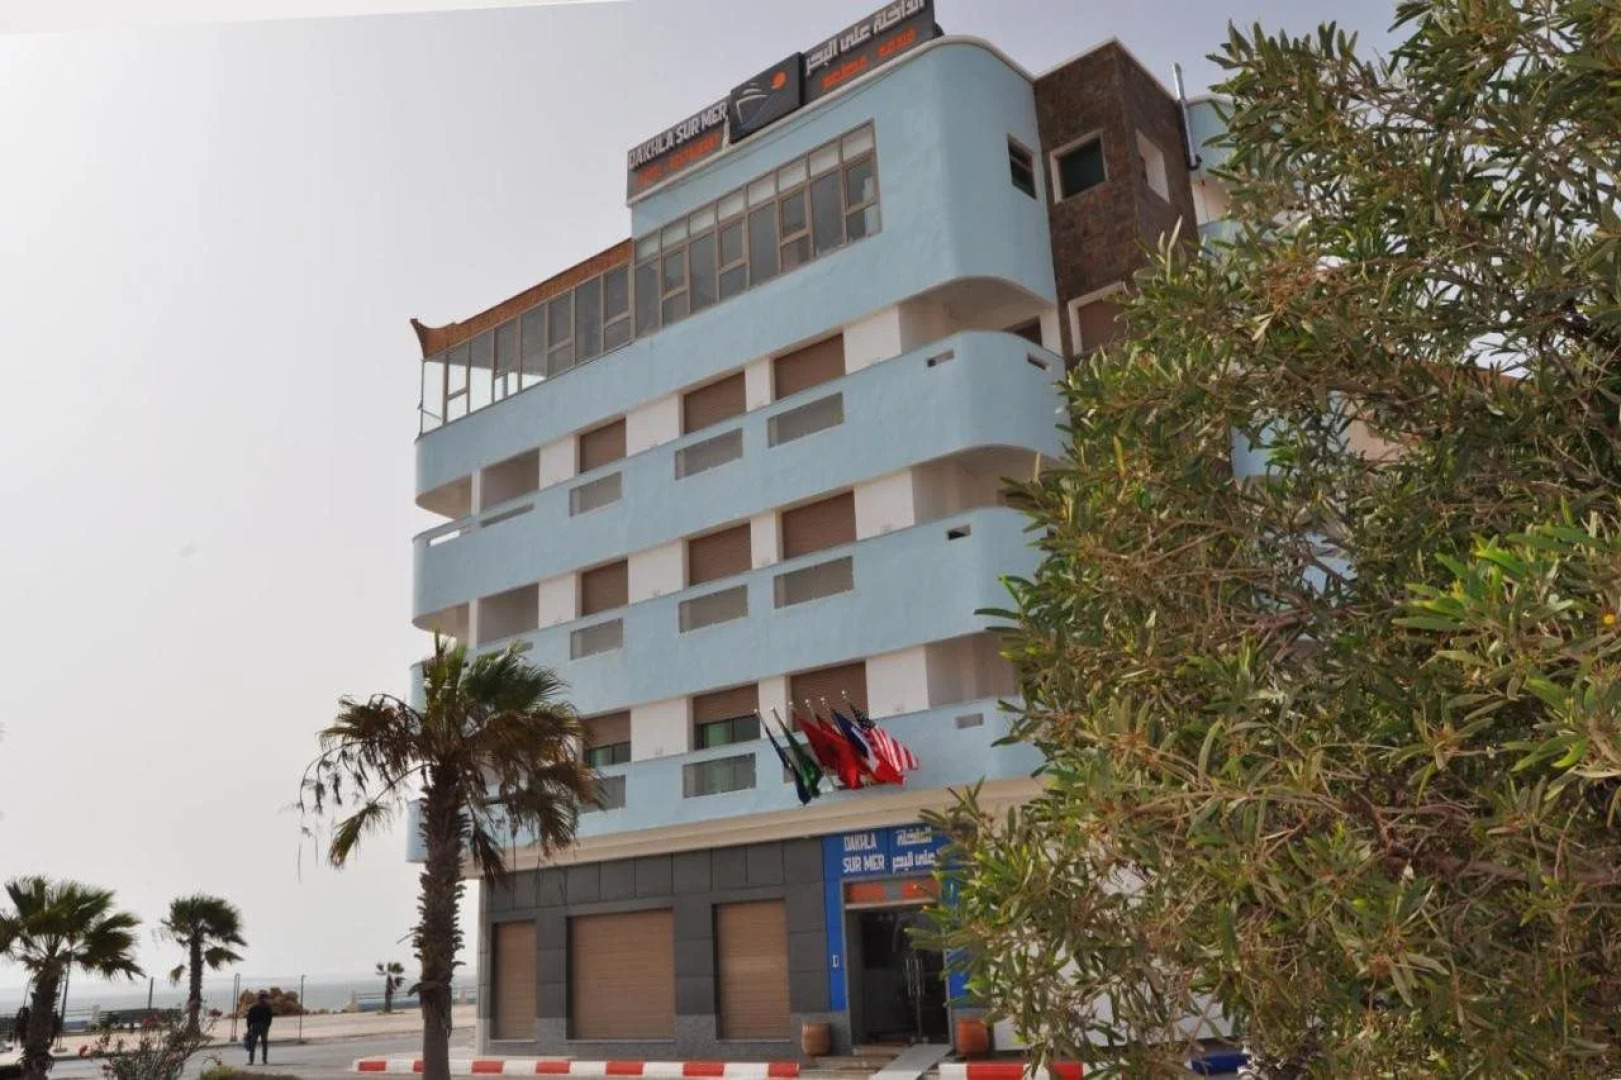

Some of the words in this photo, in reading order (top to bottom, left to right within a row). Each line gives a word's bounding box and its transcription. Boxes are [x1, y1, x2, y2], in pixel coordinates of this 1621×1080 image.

[628, 130, 674, 169] DAKHLA
[674, 116, 700, 144] SUR
[699, 101, 728, 131] MER
[843, 832, 877, 852] DAKHLA
[842, 855, 862, 874] SUR
[864, 853, 885, 871] MER
